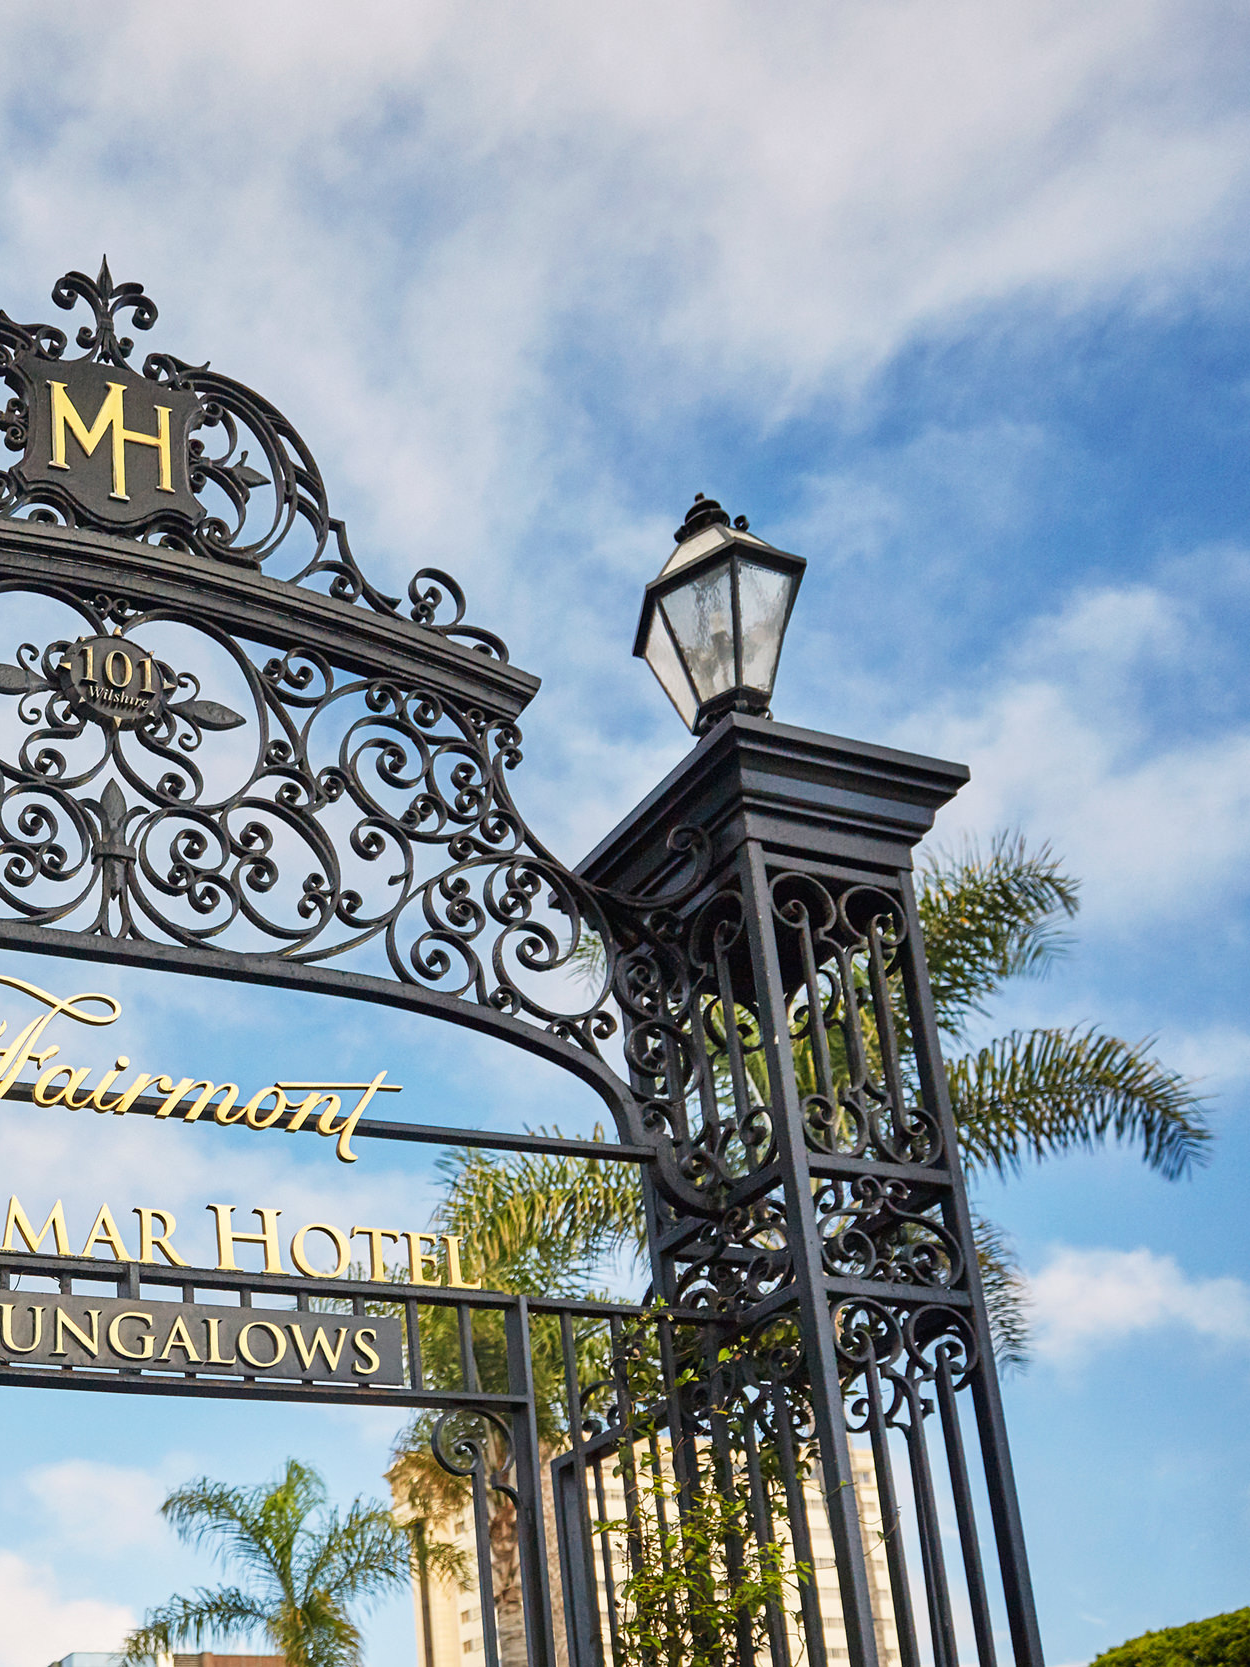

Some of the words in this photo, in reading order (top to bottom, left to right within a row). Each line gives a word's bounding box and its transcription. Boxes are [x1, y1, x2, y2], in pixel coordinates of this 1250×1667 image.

[46, 379, 176, 501] MH
[80, 646, 156, 694] 101
[89, 685, 150, 708] Wilshire
[206, 1204, 482, 1290] HOTEL
